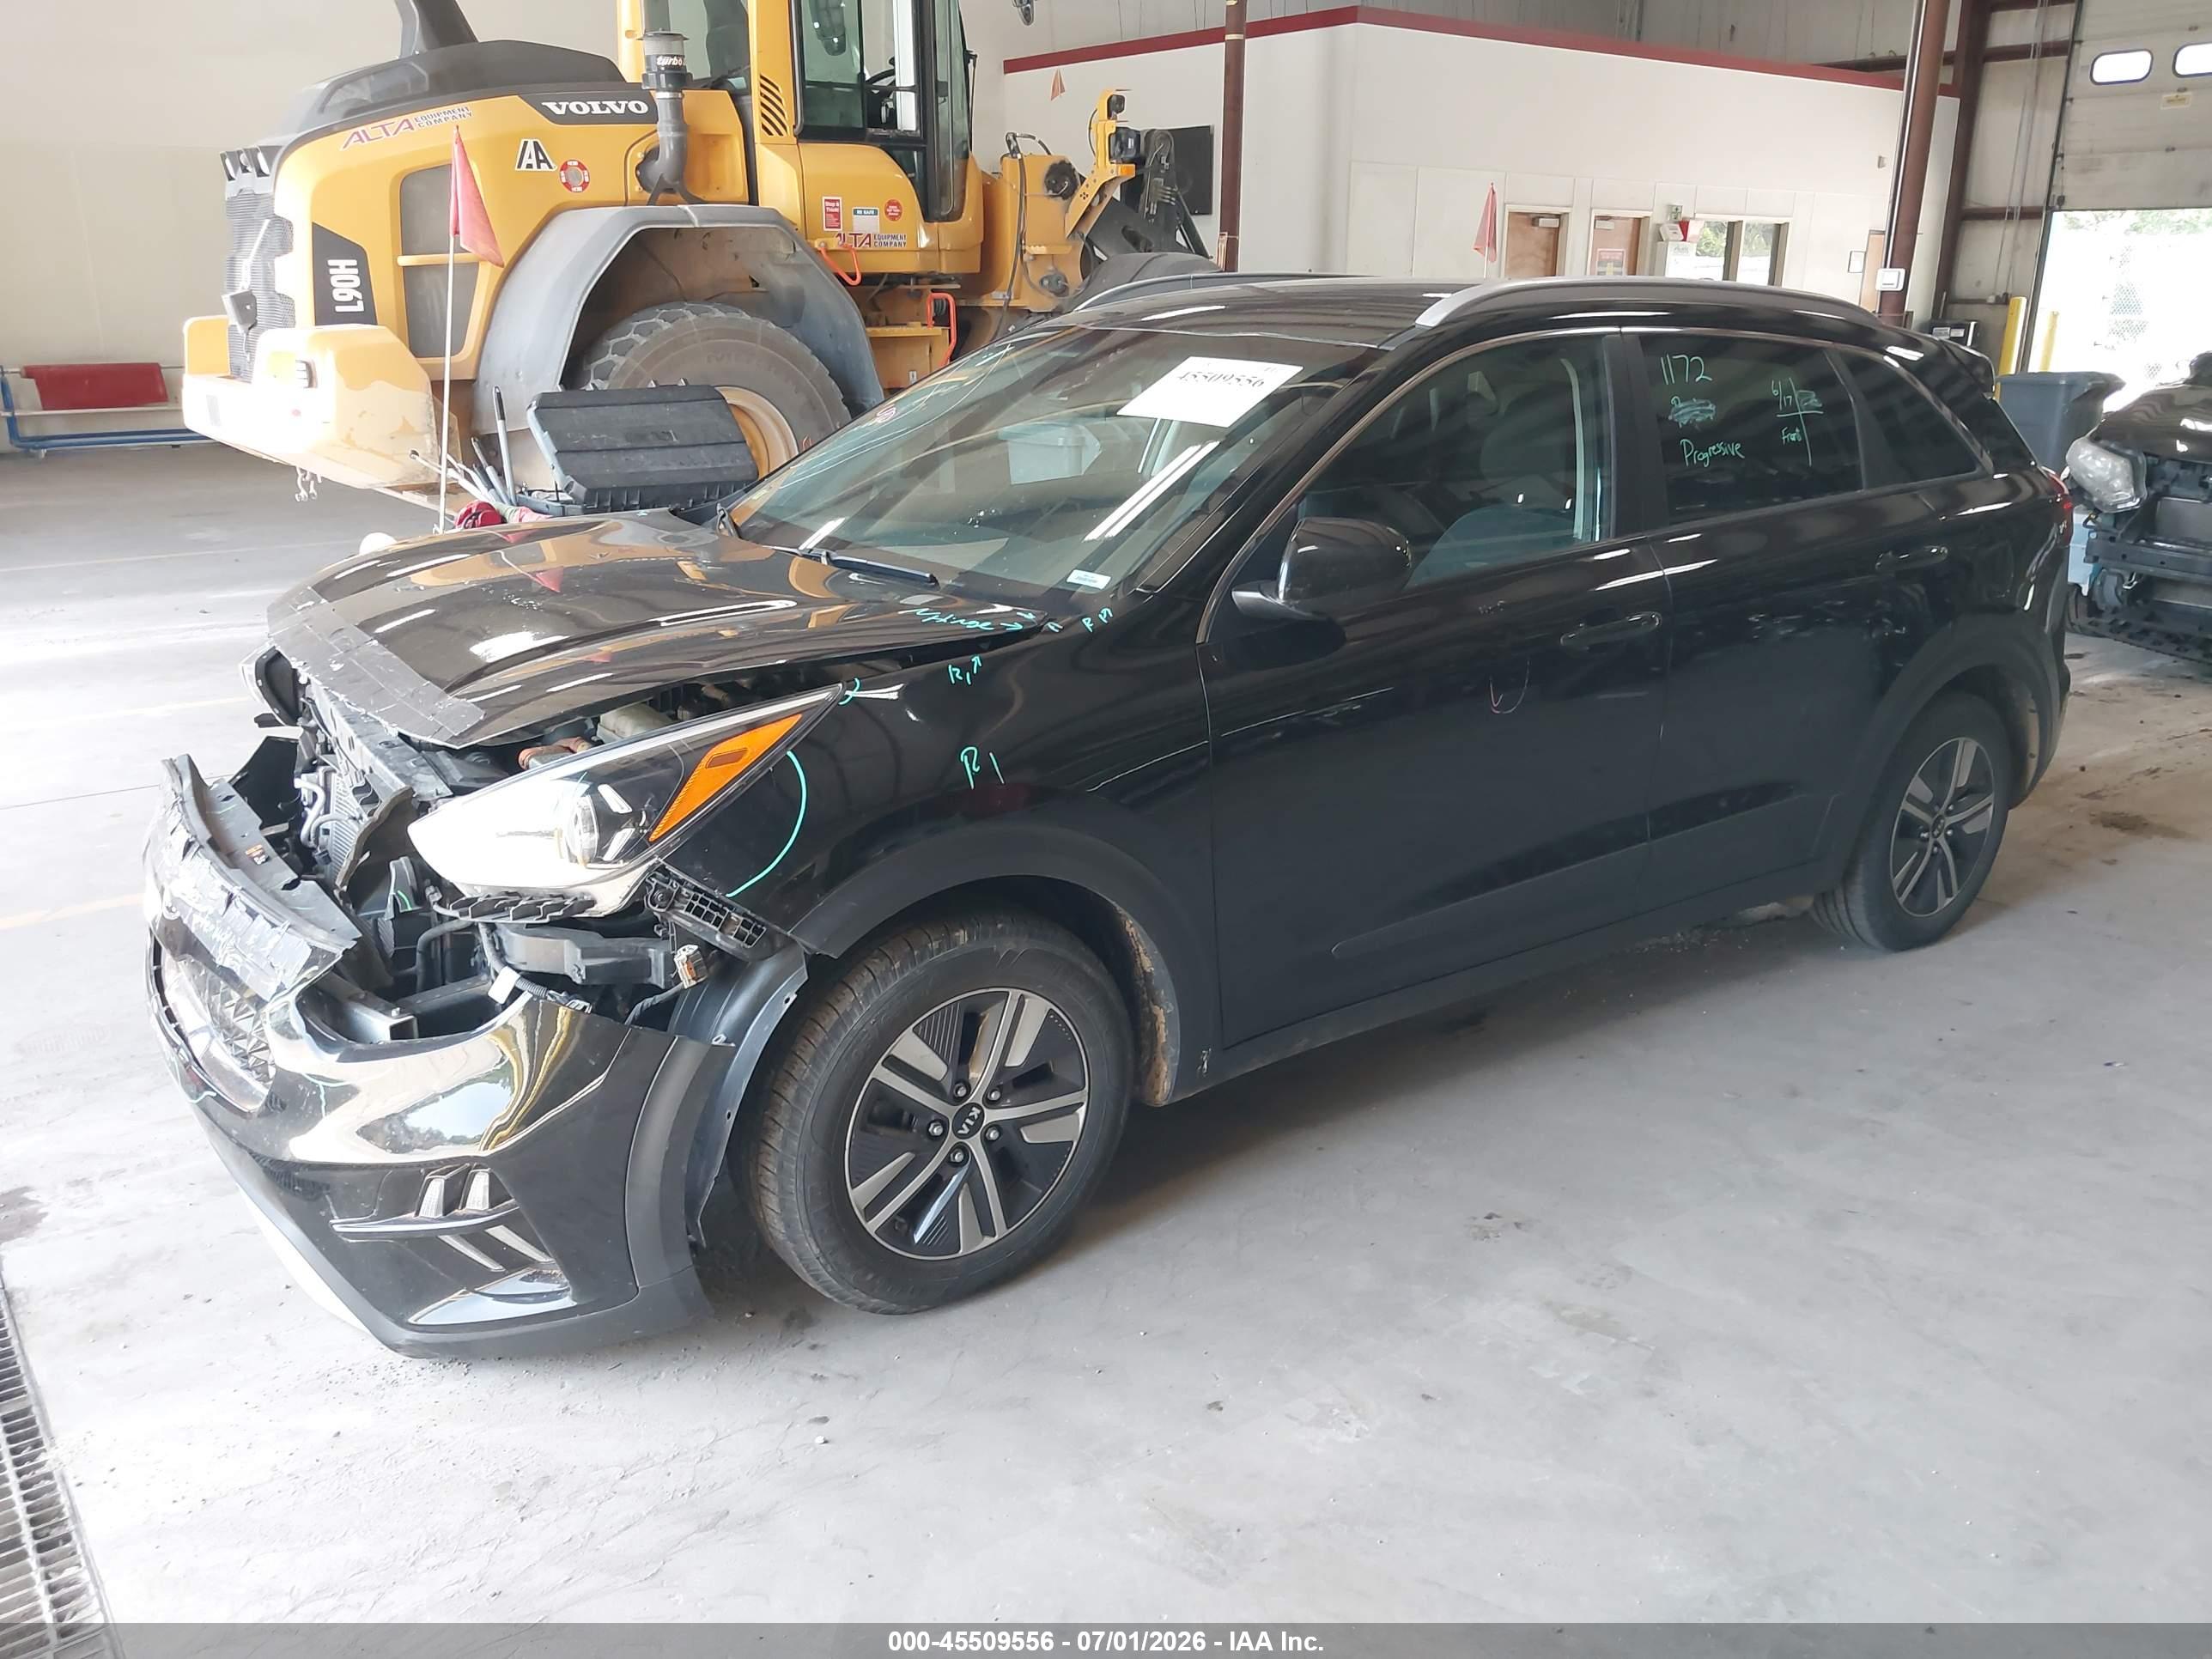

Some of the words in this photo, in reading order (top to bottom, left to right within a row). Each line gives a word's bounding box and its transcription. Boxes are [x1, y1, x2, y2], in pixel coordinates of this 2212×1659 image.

[414, 106, 471, 123] EQUIPMENT
[417, 112, 472, 128] COMPANY
[542, 100, 649, 115] VOLVO
[343, 118, 415, 149] ALTA
[327, 259, 364, 312] L90H
[1661, 354, 1713, 386] 1172
[1680, 439, 1745, 467] Progressive
[957, 1106, 981, 1134] KIA
